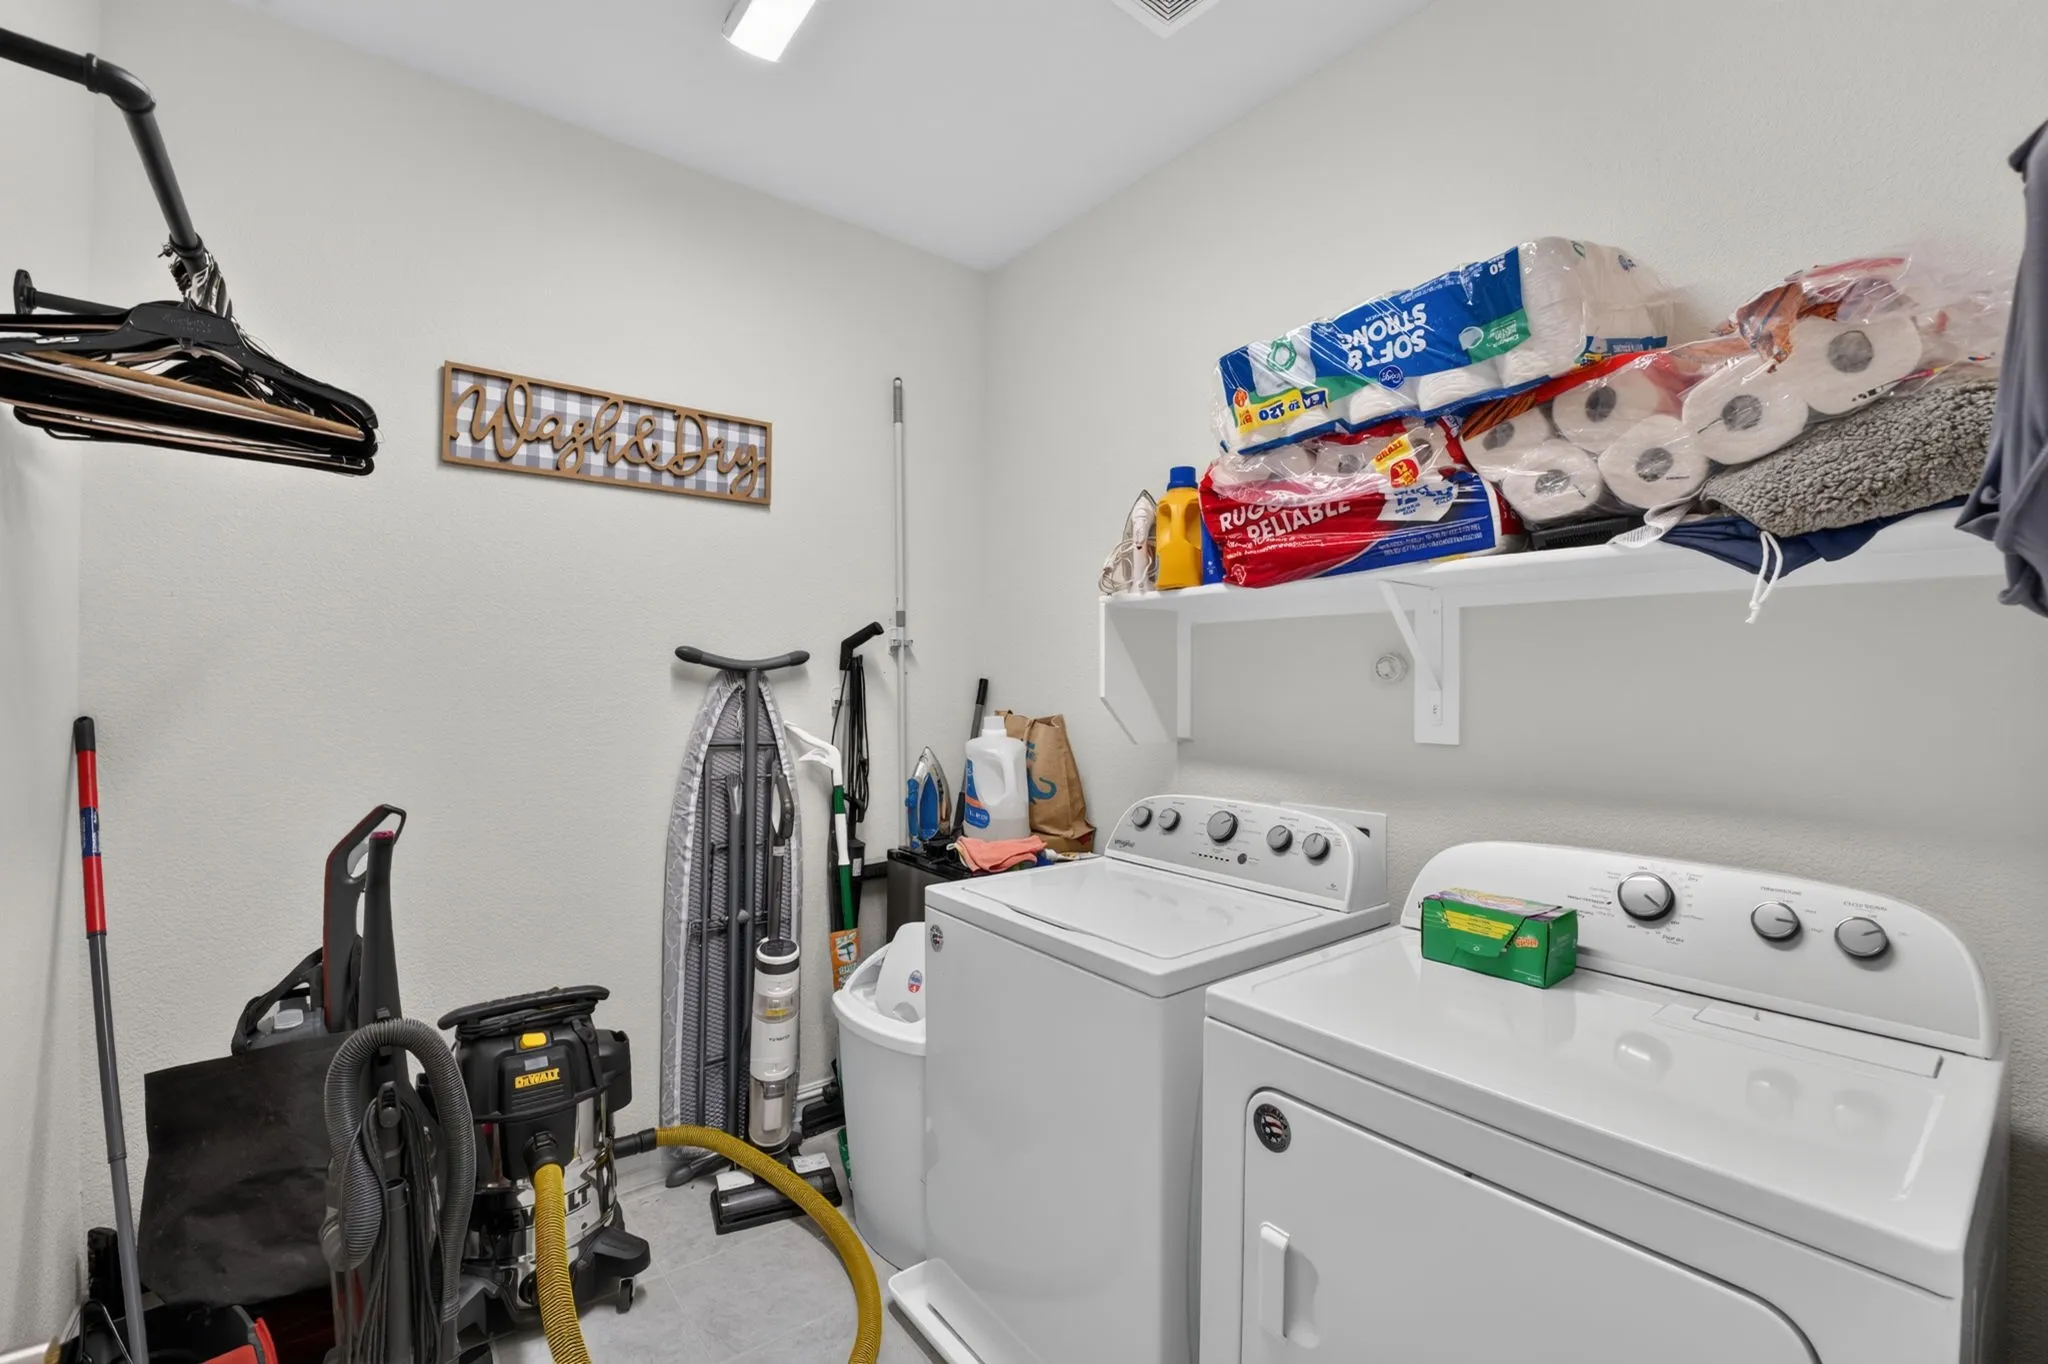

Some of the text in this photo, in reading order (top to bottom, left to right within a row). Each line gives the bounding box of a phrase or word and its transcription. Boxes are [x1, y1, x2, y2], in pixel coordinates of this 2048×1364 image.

[1364, 328, 1426, 368] SOFT
[451, 377, 625, 474] Wash
[668, 408, 767, 498] Dry
[1246, 501, 1351, 540] RELIABLE
